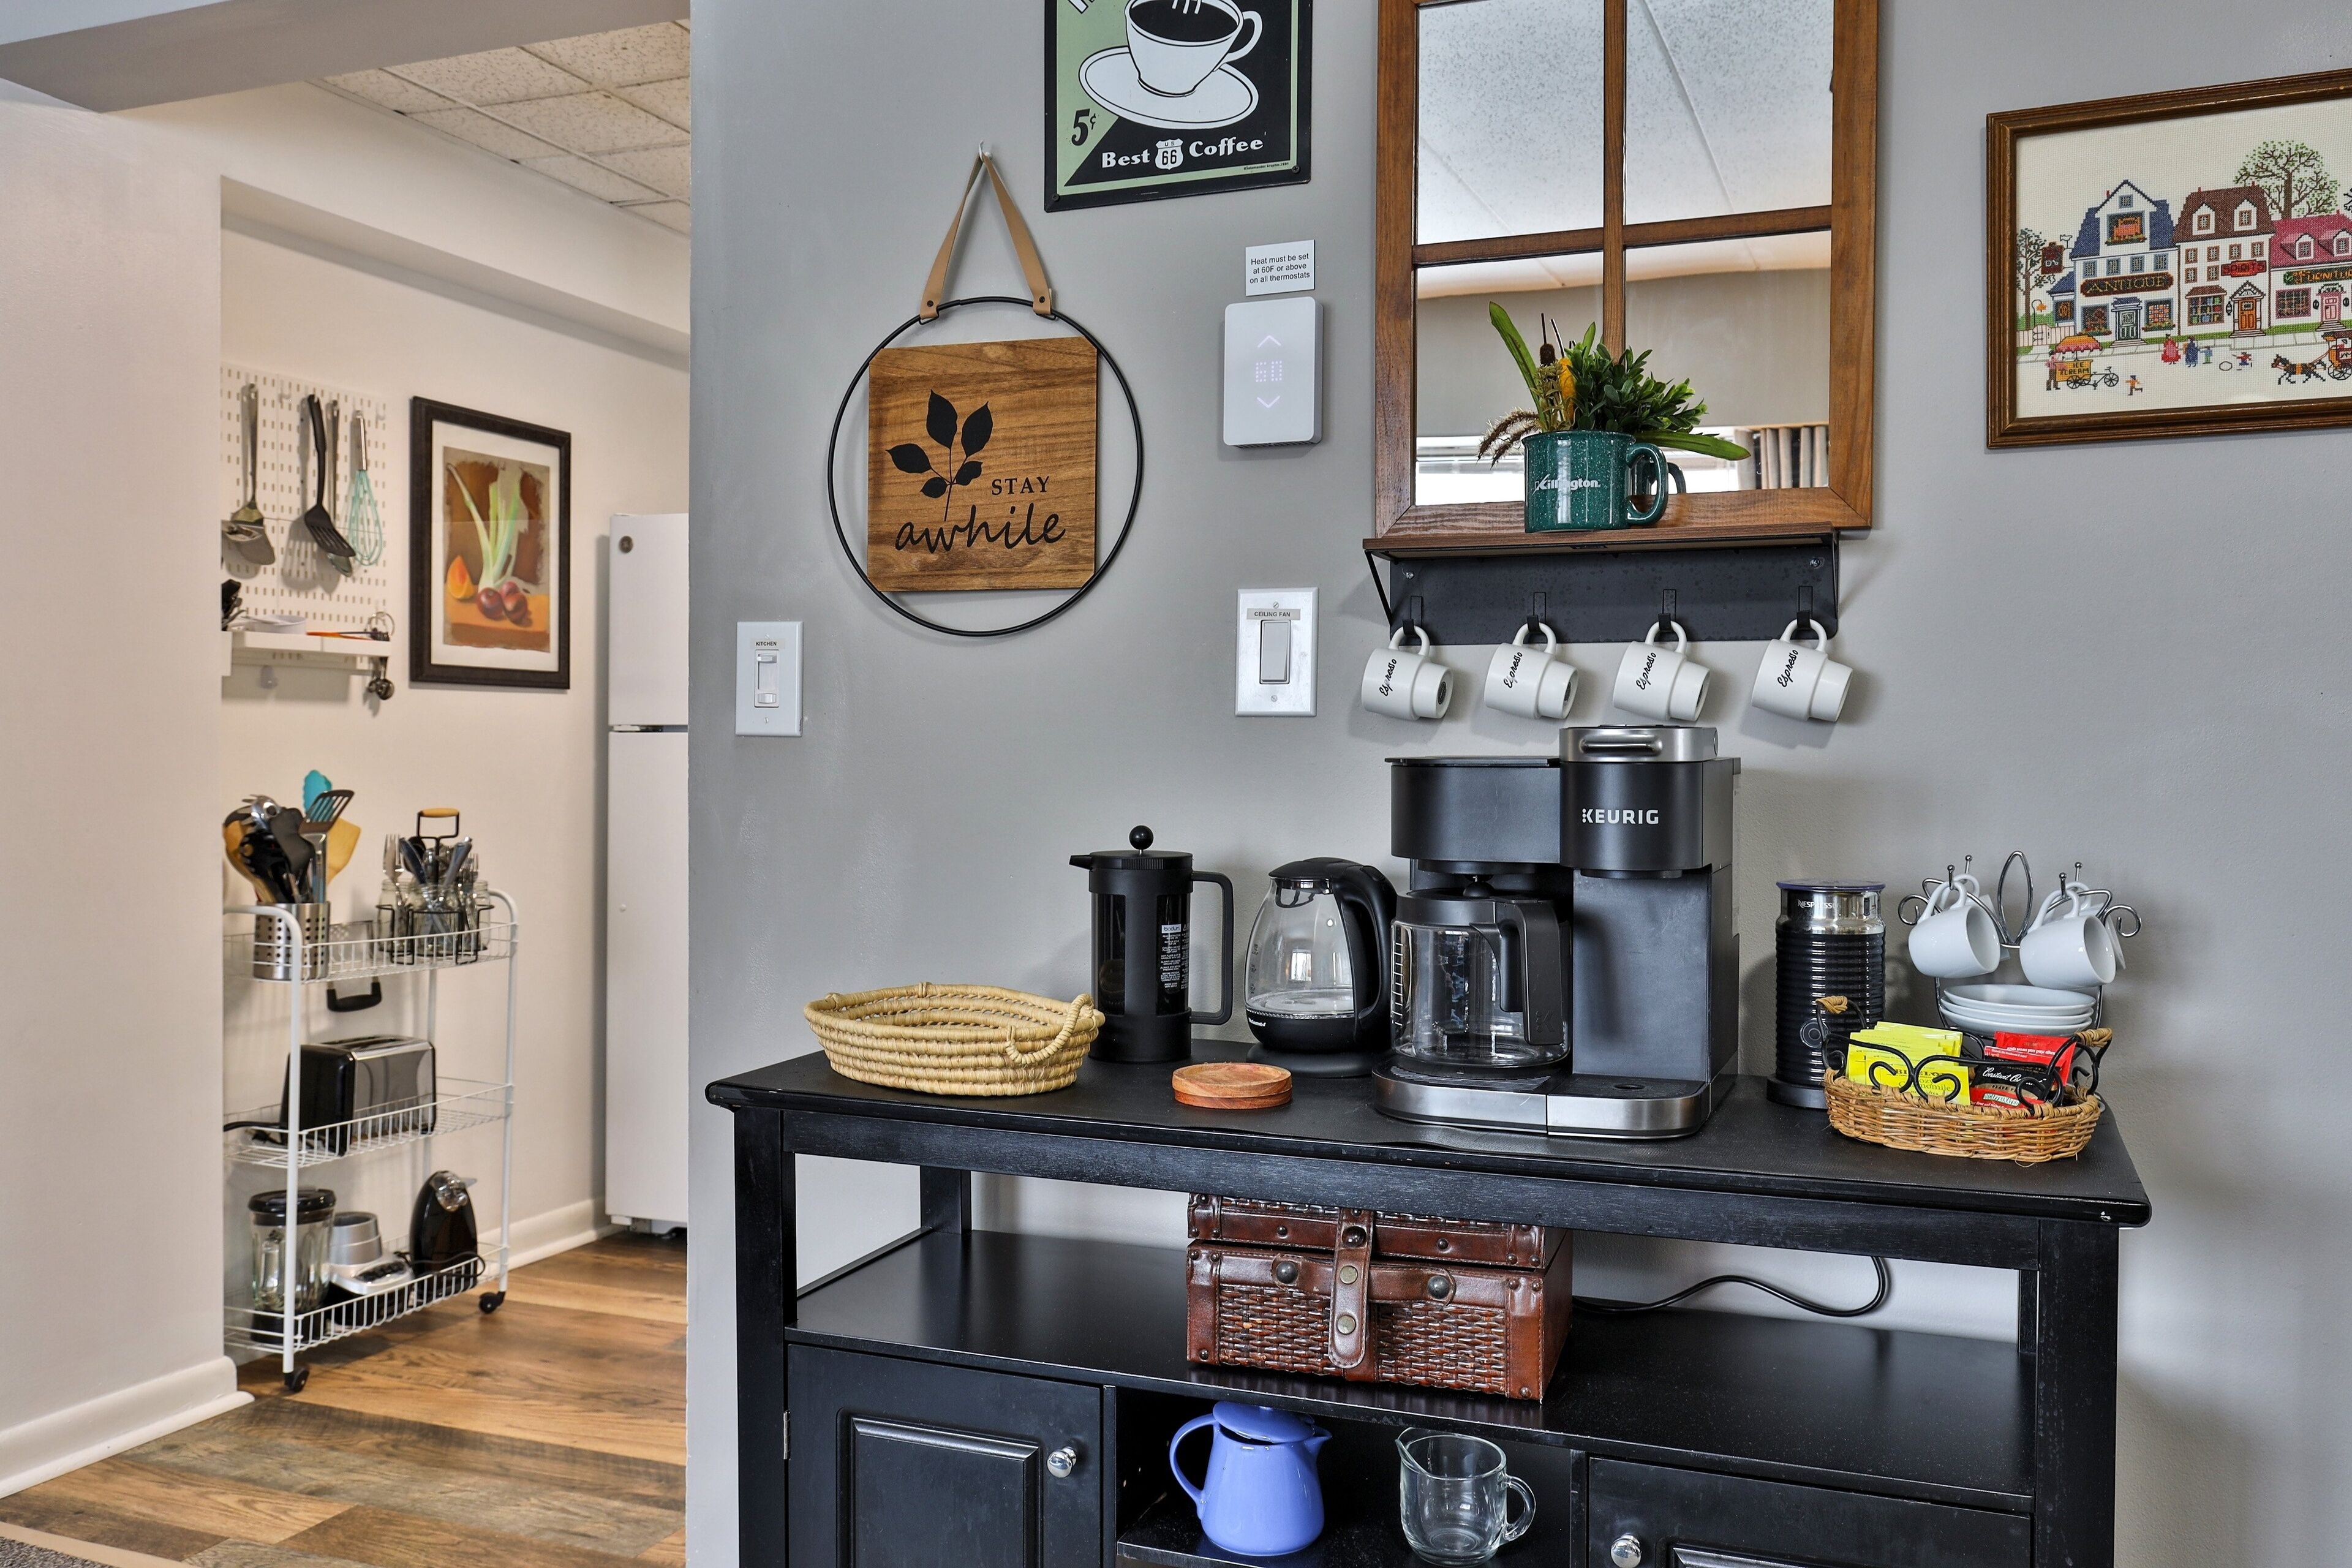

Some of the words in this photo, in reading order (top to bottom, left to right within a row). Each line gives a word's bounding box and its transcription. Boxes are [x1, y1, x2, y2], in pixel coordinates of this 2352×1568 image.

[1102, 149, 1150, 168] Best
[1189, 137, 1264, 157] Coffee
[1162, 149, 1177, 165] 66
[1270, 271, 1310, 282] thermostats
[992, 476, 1050, 496] STAY
[1532, 474, 1599, 496] Killgton
[894, 502, 1066, 554] awhile
[1379, 658, 1397, 696] Espresso
[1636, 652, 1656, 690] Espresso
[1777, 649, 1798, 687] Espresso
[1582, 808, 1659, 824] KEURIG
[1798, 899, 1838, 908] NESPSSO
